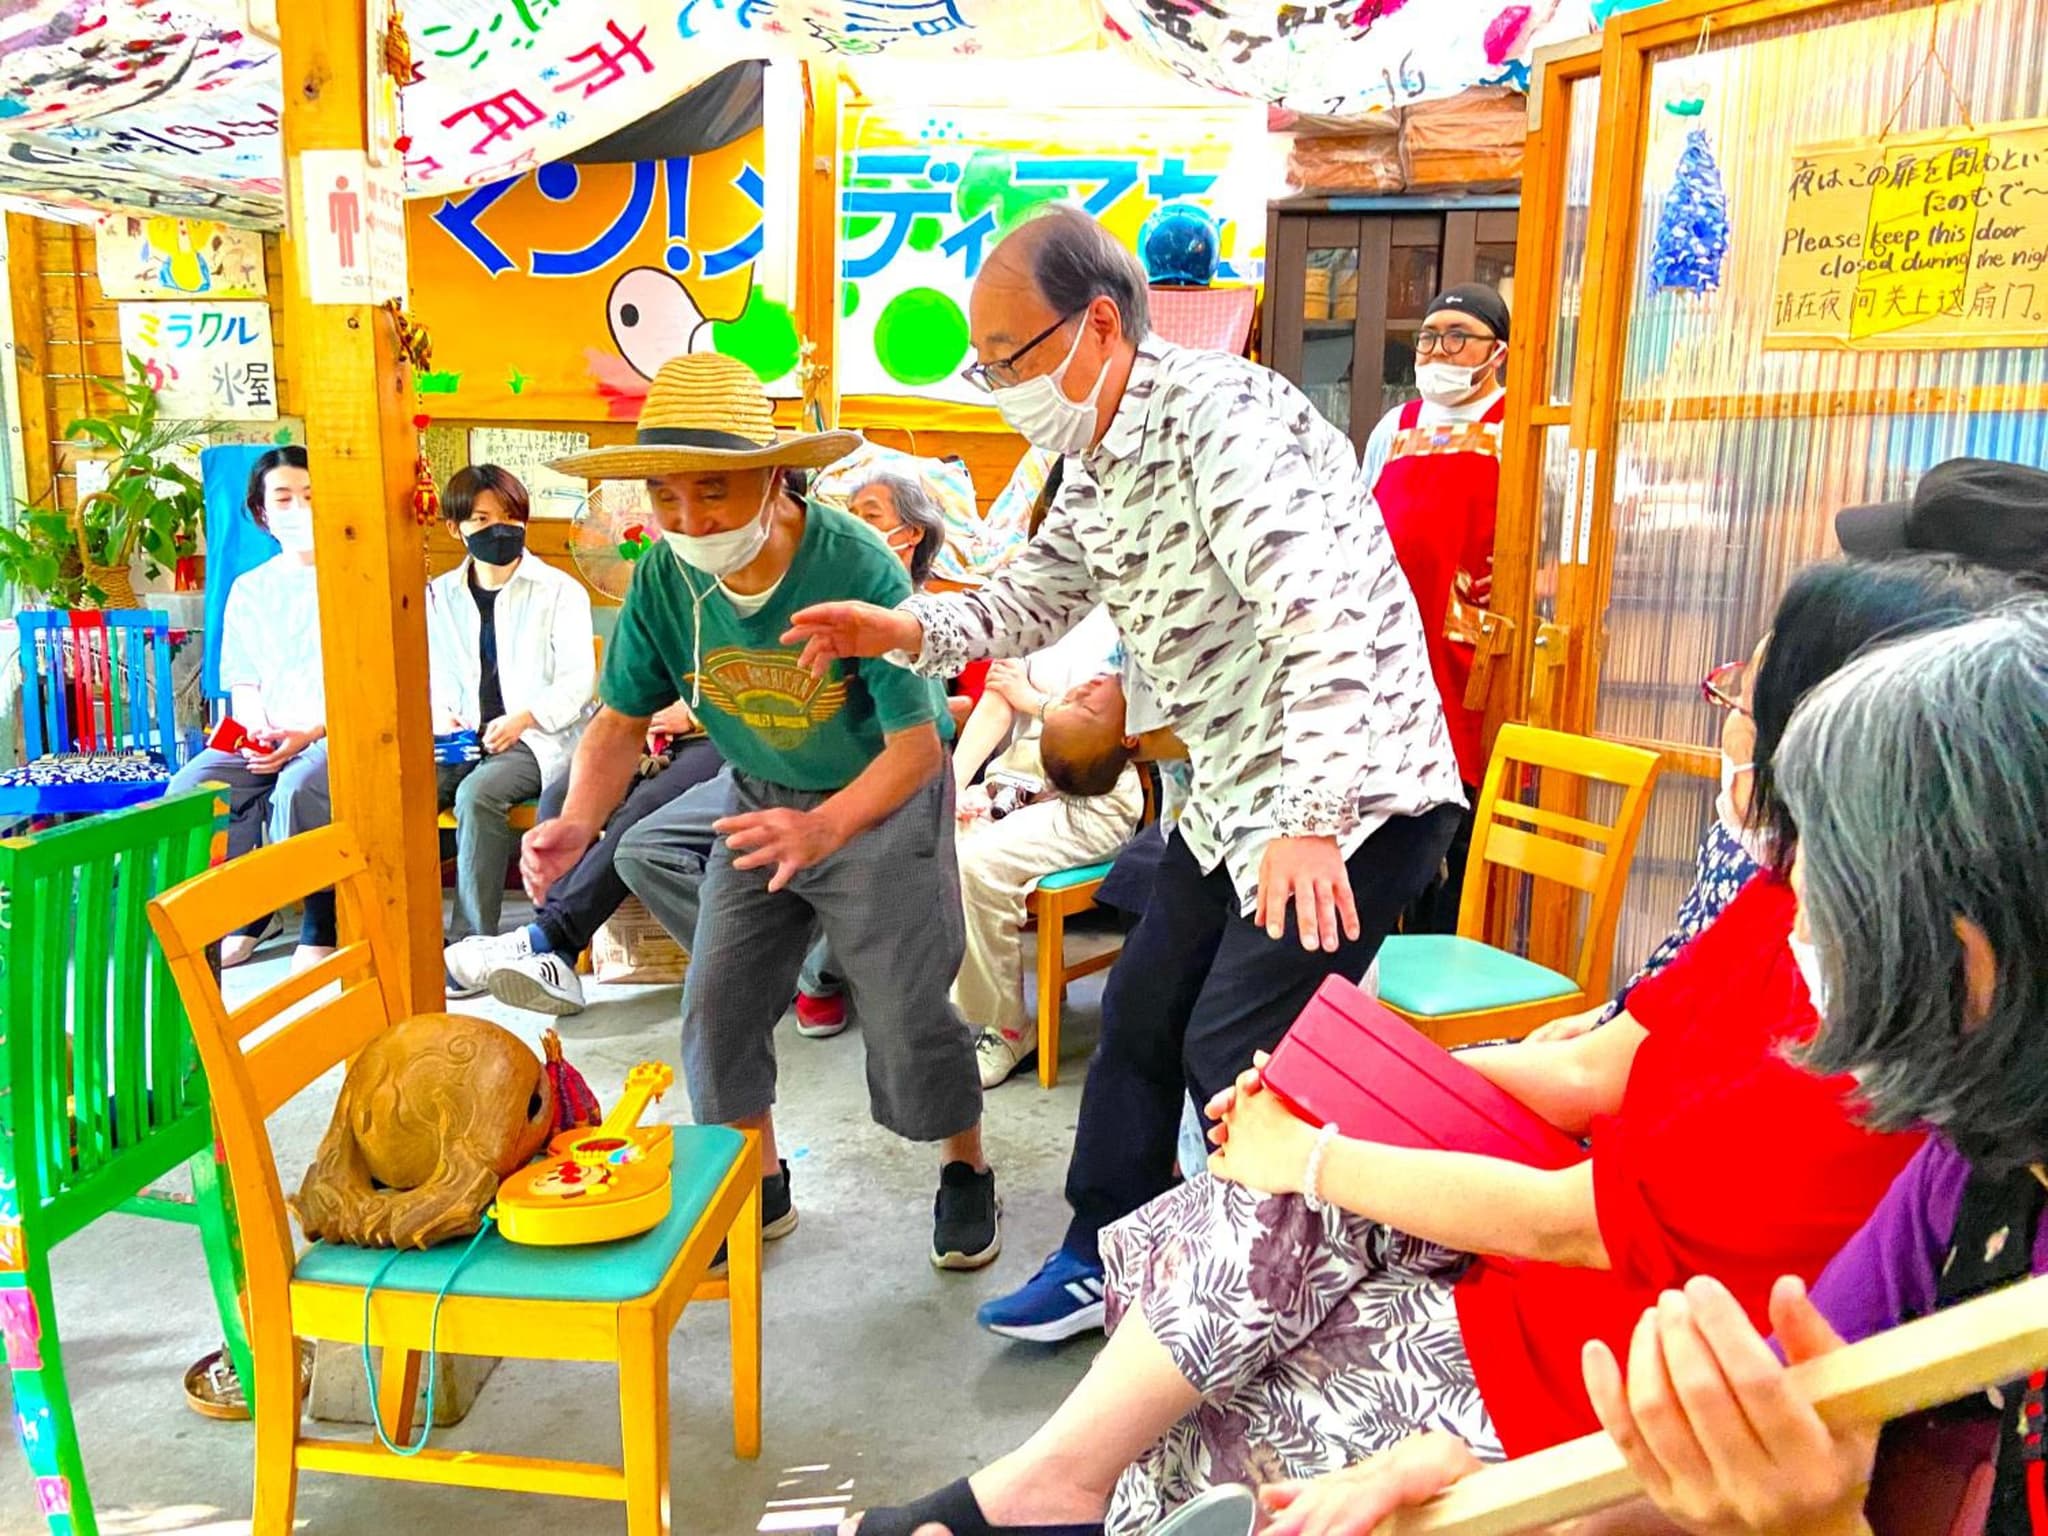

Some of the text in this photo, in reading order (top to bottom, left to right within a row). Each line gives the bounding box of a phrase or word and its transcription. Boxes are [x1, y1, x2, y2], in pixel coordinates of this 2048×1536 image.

[1789, 147, 2048, 202] 夜はこの扉を閉めとい
[1781, 217, 2027, 256] Please keep this door
[1820, 251, 1894, 278] closed
[1901, 251, 1969, 274] during
[1976, 248, 2005, 270] the
[137, 312, 260, 348] ミラクル
